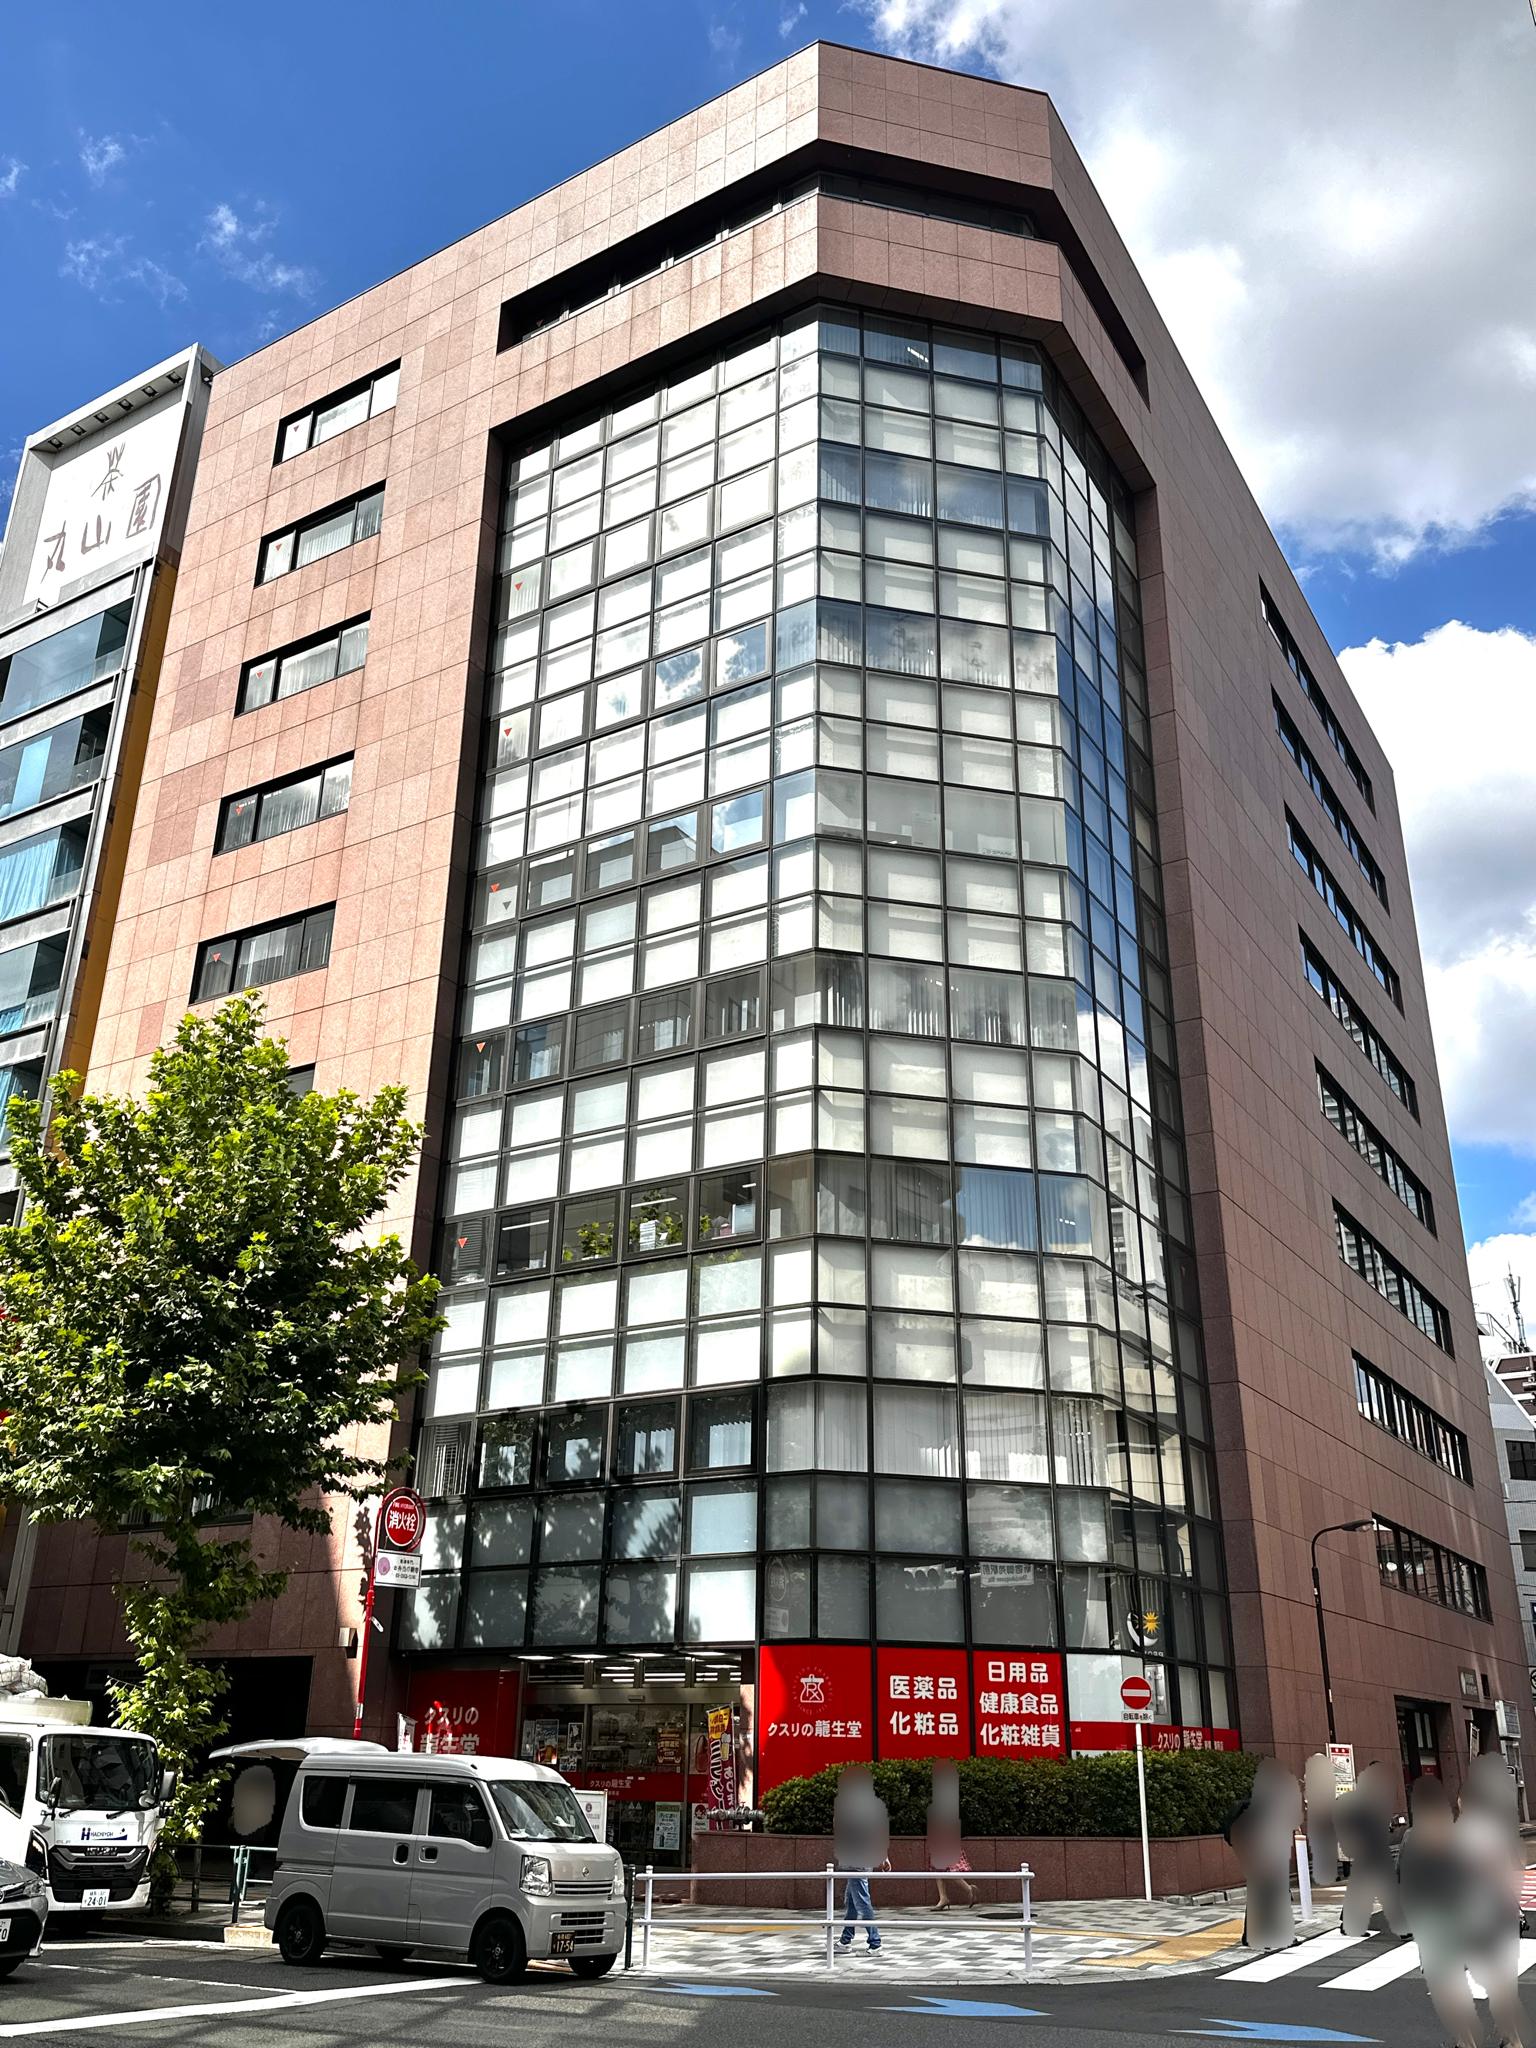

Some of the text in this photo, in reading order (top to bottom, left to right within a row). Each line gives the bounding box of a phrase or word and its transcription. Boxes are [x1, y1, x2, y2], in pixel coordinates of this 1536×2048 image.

[388, 1510, 417, 1532] 消火栓
[988, 1661, 1049, 1683] 日用品
[889, 1675, 957, 1700] 医薬品
[979, 1691, 1059, 1715] 健康食品
[424, 1706, 479, 1725] クスリの
[889, 1711, 959, 1736] 化粧品
[767, 1719, 862, 1738] クスリの龍生堂
[980, 1723, 1060, 1748] 化粧雑貨
